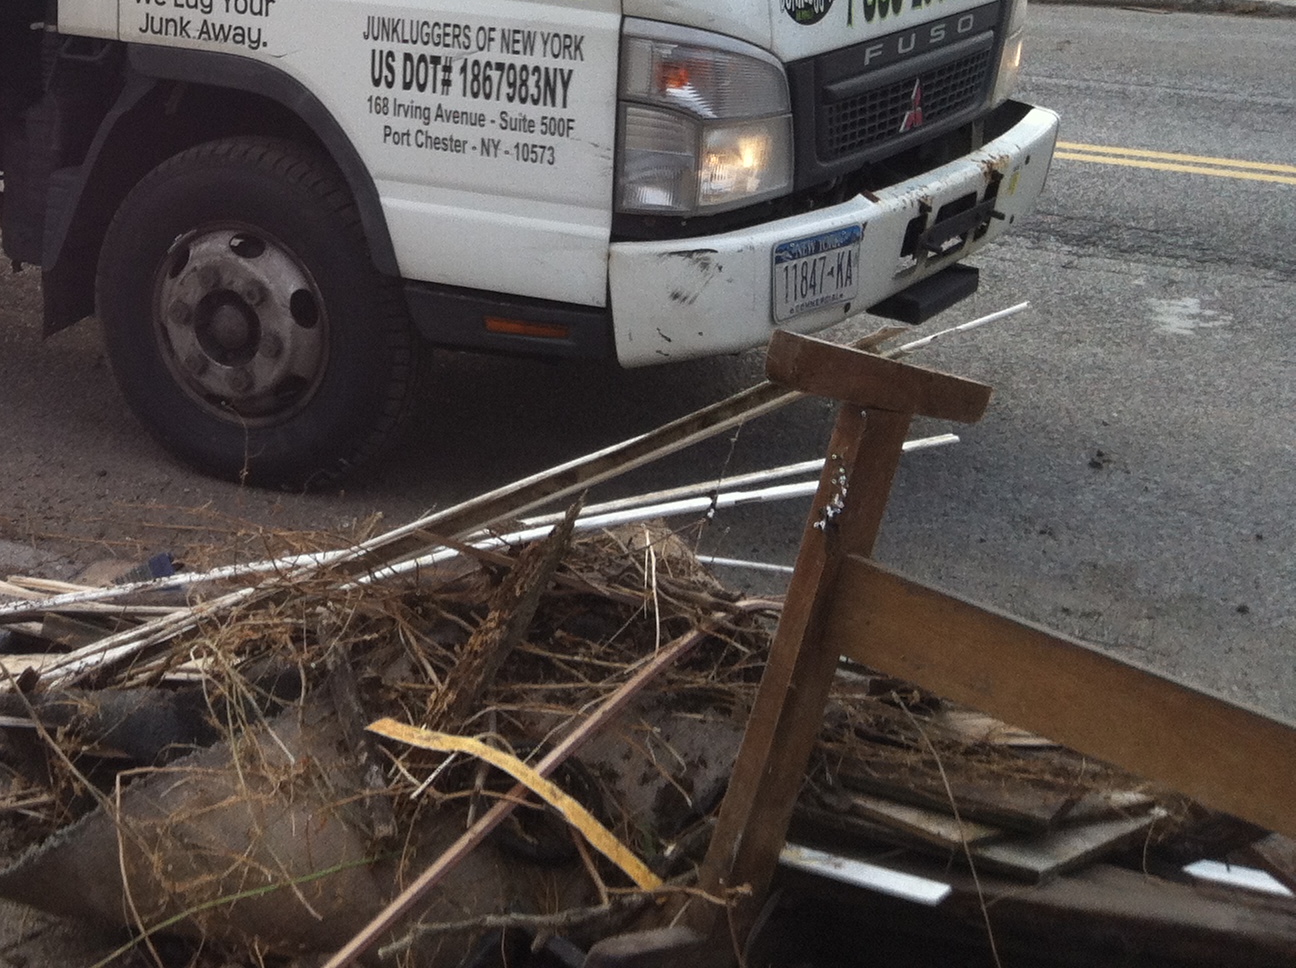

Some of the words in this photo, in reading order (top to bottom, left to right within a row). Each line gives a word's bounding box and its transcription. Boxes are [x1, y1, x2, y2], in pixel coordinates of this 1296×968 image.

[139, 13, 192, 39] Junk
[198, 19, 268, 50] Away.
[363, 15, 472, 50] JUNKLUGGERS
[475, 25, 497, 52] OF
[500, 28, 537, 57] NEW
[540, 32, 586, 62] YORK
[864, 14, 974, 66] FUSO
[370, 49, 396, 89] US
[402, 52, 453, 96] DOT#
[459, 57, 574, 109] 1867983NY
[367, 95, 389, 116] 168
[393, 98, 431, 126] Irving
[434, 103, 486, 128] Avenue
[499, 111, 536, 134] Suite
[540, 115, 576, 138] 500F
[383, 125, 411, 147] Port
[415, 129, 468, 154] Chester
[480, 138, 502, 159] NY
[513, 141, 556, 166] 10573
